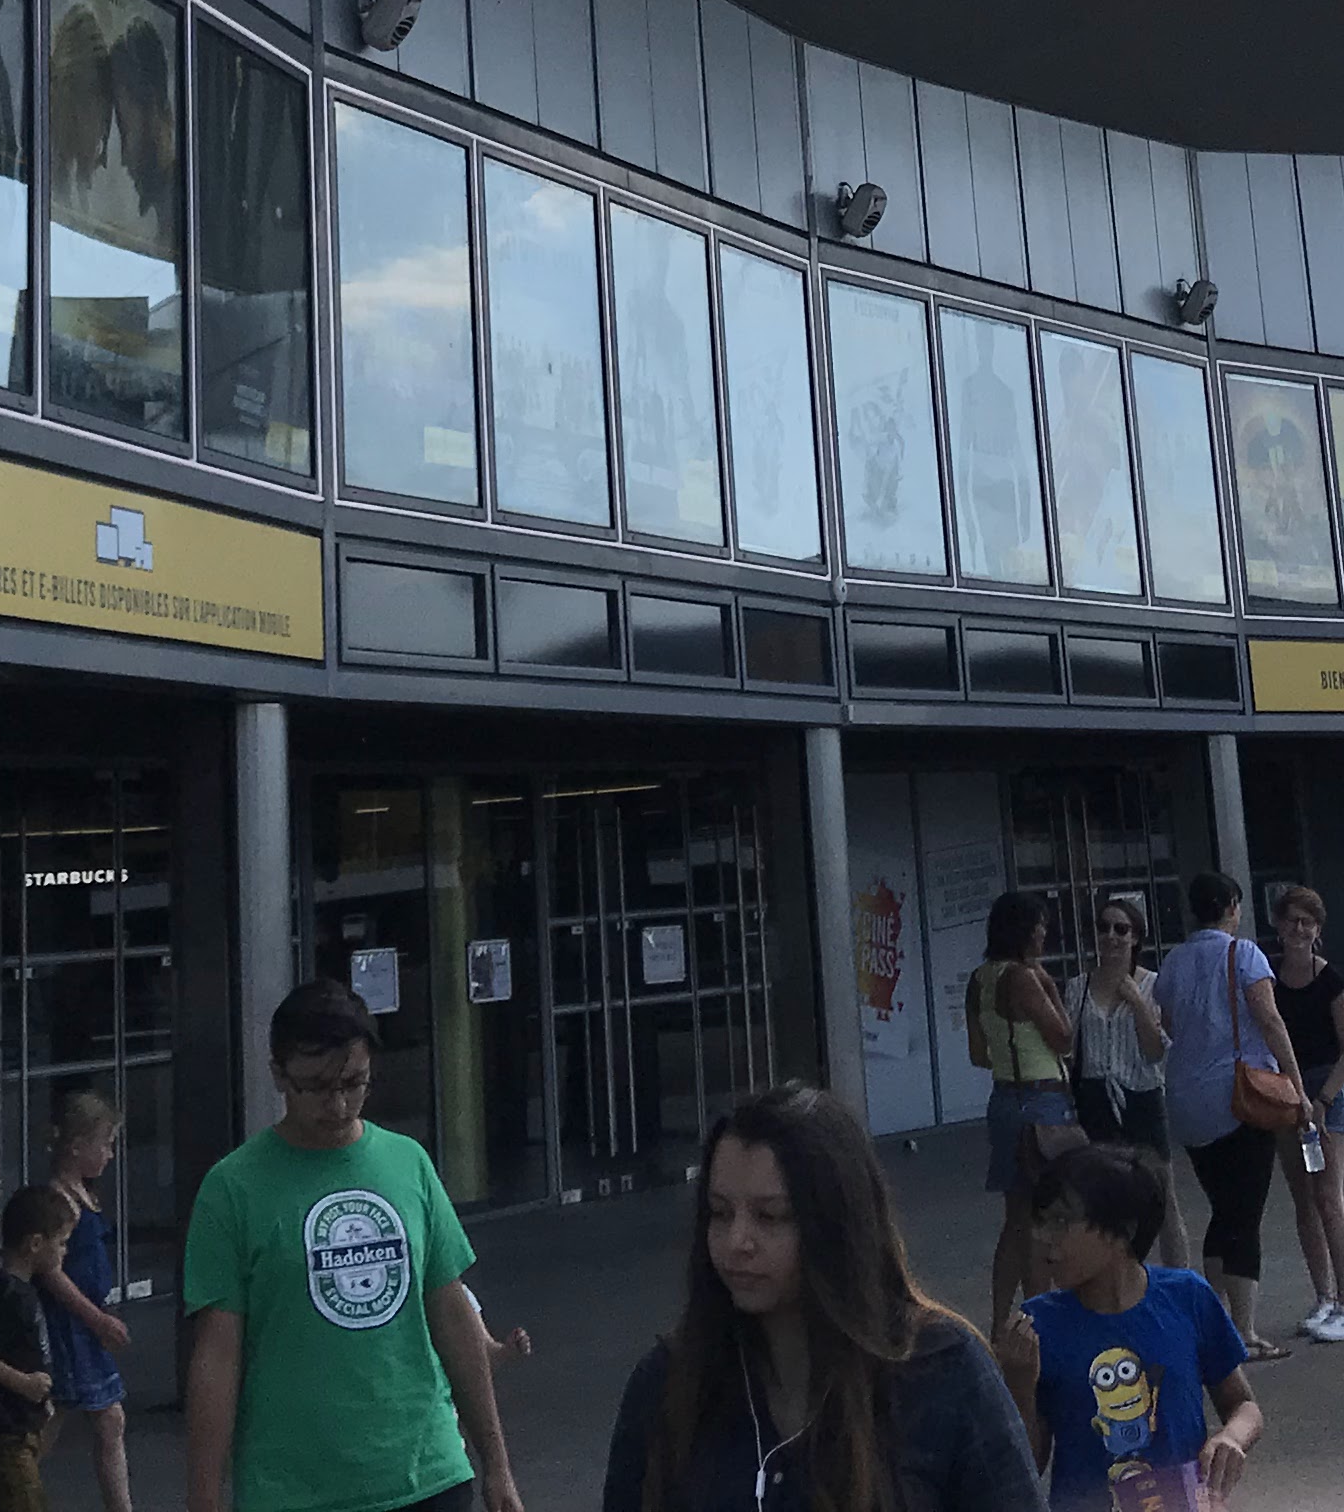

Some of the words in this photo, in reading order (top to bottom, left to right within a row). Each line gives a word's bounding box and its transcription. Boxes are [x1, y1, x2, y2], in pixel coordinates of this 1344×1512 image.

[22, 569, 35, 599] ET
[39, 573, 96, 607] E-BILLETS
[99, 583, 169, 618] DISPONIBLES
[173, 595, 190, 621] SUR
[24, 868, 129, 887] STARBUCKS
[861, 947, 895, 979] PASS
[342, 1201, 370, 1215] YOUR
[320, 1246, 397, 1269] Hadoken
[324, 1287, 370, 1316] SPECIAL
[371, 1279, 399, 1313] MOVE
